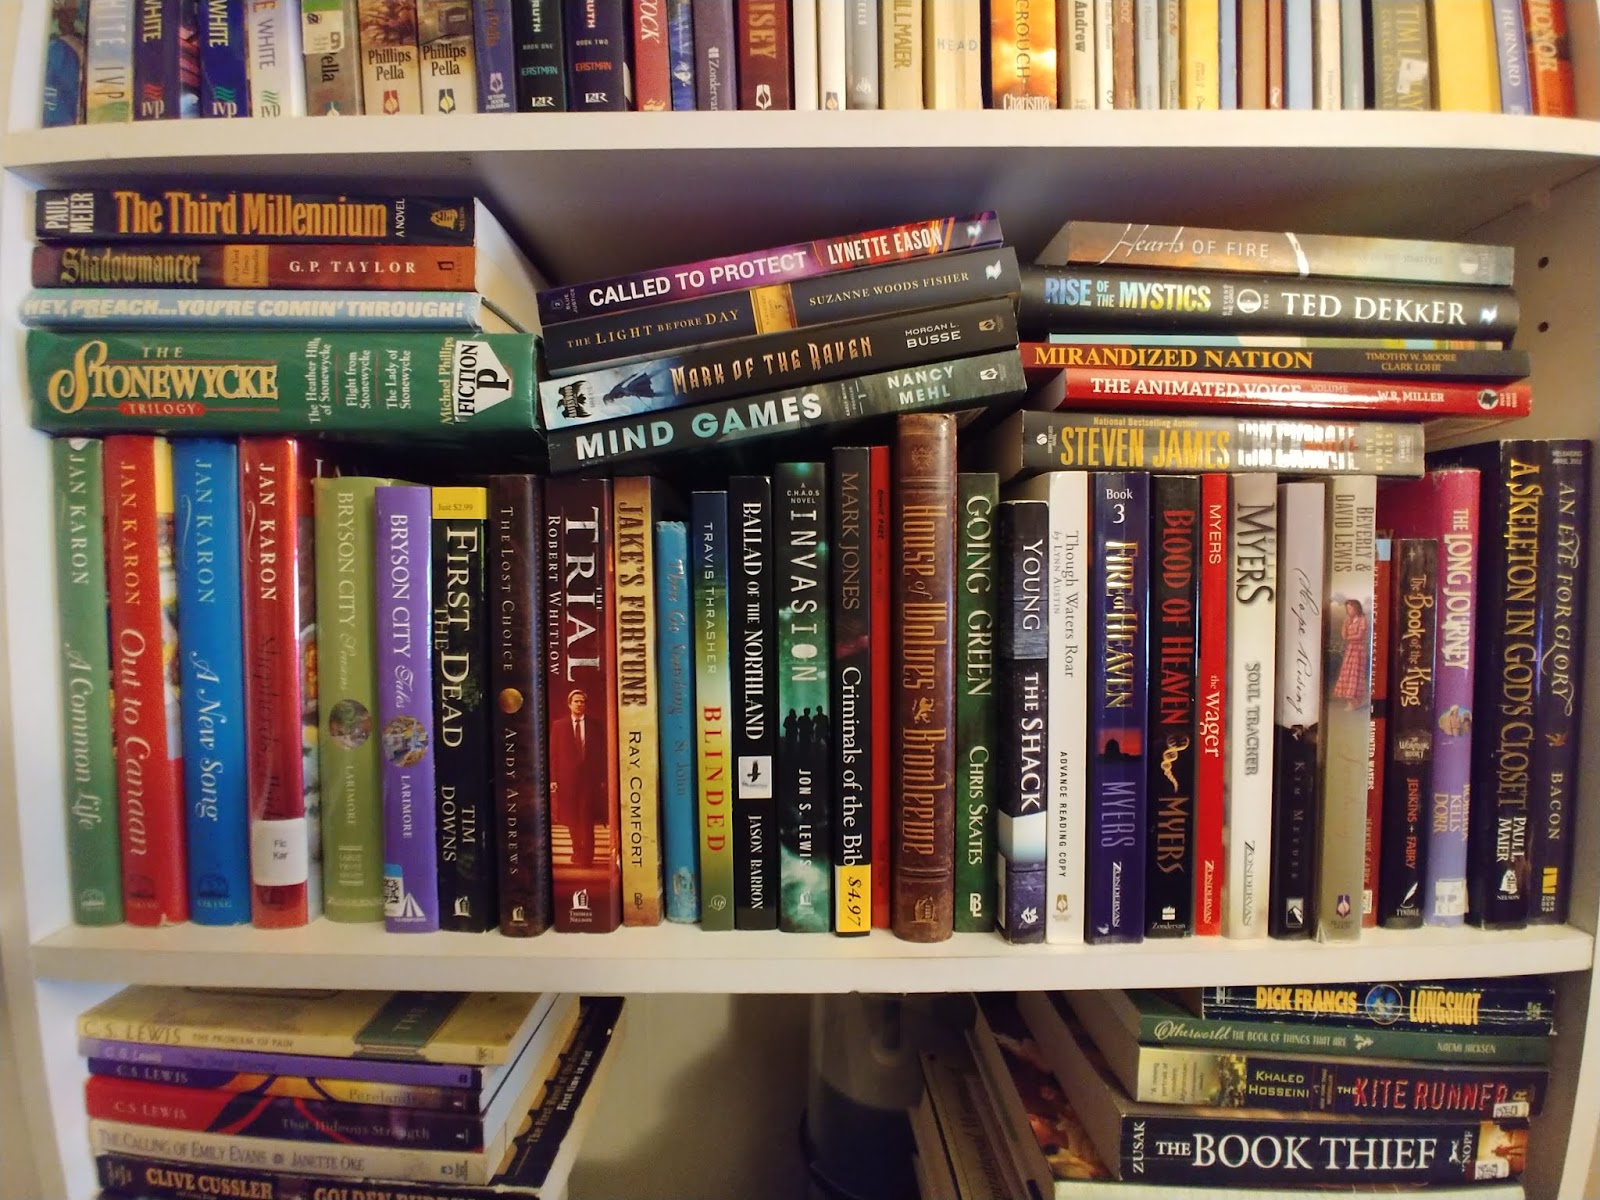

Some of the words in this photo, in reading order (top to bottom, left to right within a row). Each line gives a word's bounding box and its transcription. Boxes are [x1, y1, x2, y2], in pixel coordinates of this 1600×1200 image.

[256, 18, 276, 70] WHITE
[368, 48, 412, 65] Phillips
[422, 43, 467, 61] Phillips
[937, 38, 978, 51] HEAD
[1503, 9, 1521, 87] HURNARD
[375, 65, 405, 81] Pella
[431, 60, 461, 76] Pella
[521, 65, 558, 77] EASTMAN
[575, 62, 612, 72] EASTMAN
[69, 192, 94, 233] MEIER
[113, 191, 163, 234] The
[166, 190, 238, 235] Third
[242, 192, 387, 238] Millennium
[289, 260, 305, 273] G.
[309, 261, 320, 273] P.
[331, 260, 416, 274] TAYLOR
[1096, 280, 1110, 291] OF
[567, 335, 592, 348] THE
[596, 324, 653, 345] LIGHT
[658, 316, 702, 332] BEFORE
[704, 308, 740, 326] DAY
[809, 286, 871, 307] SUZANNE
[873, 279, 919, 297] WOODS
[922, 271, 970, 289] FISHER
[1045, 277, 1093, 306] RISE
[1096, 293, 1116, 307] THE
[1119, 281, 1212, 312] MYSTICS
[1280, 292, 1343, 318] TED
[1353, 296, 1468, 326] DEKKER
[142, 346, 184, 359] THE
[385, 349, 399, 362] of
[906, 329, 962, 349] BUSSE
[1034, 346, 1199, 368] MIRANDIZED
[1203, 350, 1315, 370] NATION
[48, 340, 278, 413] STONEWYCKE
[319, 344, 332, 403] Stonewycke
[344, 352, 358, 376] from
[359, 349, 372, 409] Stonewycke
[384, 366, 400, 388] Lady
[458, 343, 479, 414] FICTION
[887, 365, 955, 389] NANCY
[1381, 363, 1414, 372] CLARK
[1415, 363, 1443, 372] LOHR
[322, 404, 333, 416] of
[345, 378, 358, 407] Flight
[385, 390, 399, 410] The
[899, 383, 951, 405] MEHL
[576, 420, 674, 460] MIND
[691, 392, 823, 438] GAMES
[1093, 416, 1126, 427] National
[1128, 417, 1172, 429] Bestselling
[1173, 418, 1199, 428] Author
[1060, 426, 1145, 468] STEVEN
[1152, 430, 1232, 471] JAMES
[69, 453, 86, 495] JAN
[121, 460, 137, 508] JAN
[195, 459, 213, 503] JAN
[259, 462, 276, 507] JAN
[1105, 489, 1133, 500] Book
[842, 472, 860, 538] MARK
[1112, 503, 1126, 524] 3
[1334, 494, 1356, 529] DAVID
[1452, 508, 1470, 531] THE
[70, 504, 90, 585] KARON
[338, 491, 356, 573] BRYSON
[548, 515, 562, 583] ROBERT
[617, 501, 646, 588] JAKE'S
[704, 522, 715, 580] TRAVIS
[743, 502, 763, 575] BALLAD
[966, 495, 992, 595] GOING
[1209, 504, 1223, 565] MYERS
[1235, 502, 1275, 606] MYERS
[1334, 533, 1355, 573] LEWIS
[1355, 506, 1375, 560] BEVERLY
[122, 519, 141, 606] KARON
[196, 514, 216, 604] KARON
[260, 519, 277, 601] KARON
[839, 541, 861, 611] JONES
[1062, 529, 1079, 588] Though
[1355, 564, 1373, 574] &
[1443, 534, 1473, 585] LONG
[338, 580, 356, 628] CITY
[746, 581, 760, 598] OF
[1022, 538, 1043, 631] YOUNG
[1410, 574, 1428, 591] The
[549, 590, 562, 675] WHITLOW
[706, 586, 717, 674] THRASHER
[747, 602, 760, 624] THE
[1065, 592, 1079, 640] Waters
[1402, 592, 1435, 641] Book
[1441, 584, 1471, 671] JOURNEY
[120, 627, 147, 687] Out
[619, 595, 648, 707] FORTUNE
[966, 609, 993, 696] GREEN
[1064, 644, 1079, 679] Roar
[1409, 649, 1422, 665] the
[1410, 638, 1421, 649] of
[743, 629, 765, 740] NORTHLAND
[1024, 672, 1040, 711] THE
[1245, 661, 1262, 705] SOUL
[1399, 666, 1433, 707] King
[122, 697, 142, 726] to
[504, 728, 518, 779] ANDY
[629, 731, 642, 769] RAY
[1245, 706, 1262, 776] TRACKER
[703, 705, 727, 852] BLINDED
[799, 769, 813, 796] JON
[969, 745, 990, 799] CHRIS
[1020, 717, 1044, 813] SHACK
[1059, 751, 1069, 799] ADVANCE
[125, 736, 152, 856] Canaan
[400, 774, 413, 838] LARIMORE
[799, 802, 812, 817] S.
[1101, 781, 1136, 848] MYERS
[1407, 778, 1420, 823] JENKINS
[1432, 792, 1450, 834] DORR
[1449, 794, 1462, 833] KELLS
[1548, 771, 1565, 840] BACON
[506, 788, 519, 876] ANDREWS
[630, 776, 643, 868] COMFORT
[968, 803, 989, 865] SKATES
[1059, 803, 1069, 848] READING
[1157, 796, 1190, 874] MYERS
[1496, 817, 1512, 863] MAIER
[799, 824, 813, 868] LEWIS
[1058, 852, 1068, 878] COPY
[1405, 836, 1418, 870] FABRY
[1112, 861, 1123, 928] ZONDERVAN
[1203, 860, 1216, 925] ZONDERVAN
[1256, 985, 1293, 1011] DICK
[1294, 987, 1358, 1015] FRANCIS
[1409, 989, 1482, 1026] LONGSHOT
[126, 1023, 182, 1045] LEWIS
[271, 1038, 295, 1049] PAIN
[144, 1067, 190, 1084] LEWIS
[1248, 1085, 1310, 1099] HOSSEINI
[1256, 1069, 1306, 1084] KHALED
[141, 1104, 188, 1121] LEWIS
[1132, 1121, 1147, 1174] ZUSAK
[1155, 1141, 1192, 1156] THE
[1192, 1133, 1313, 1170] BOOK
[1319, 1136, 1438, 1171] THIEF
